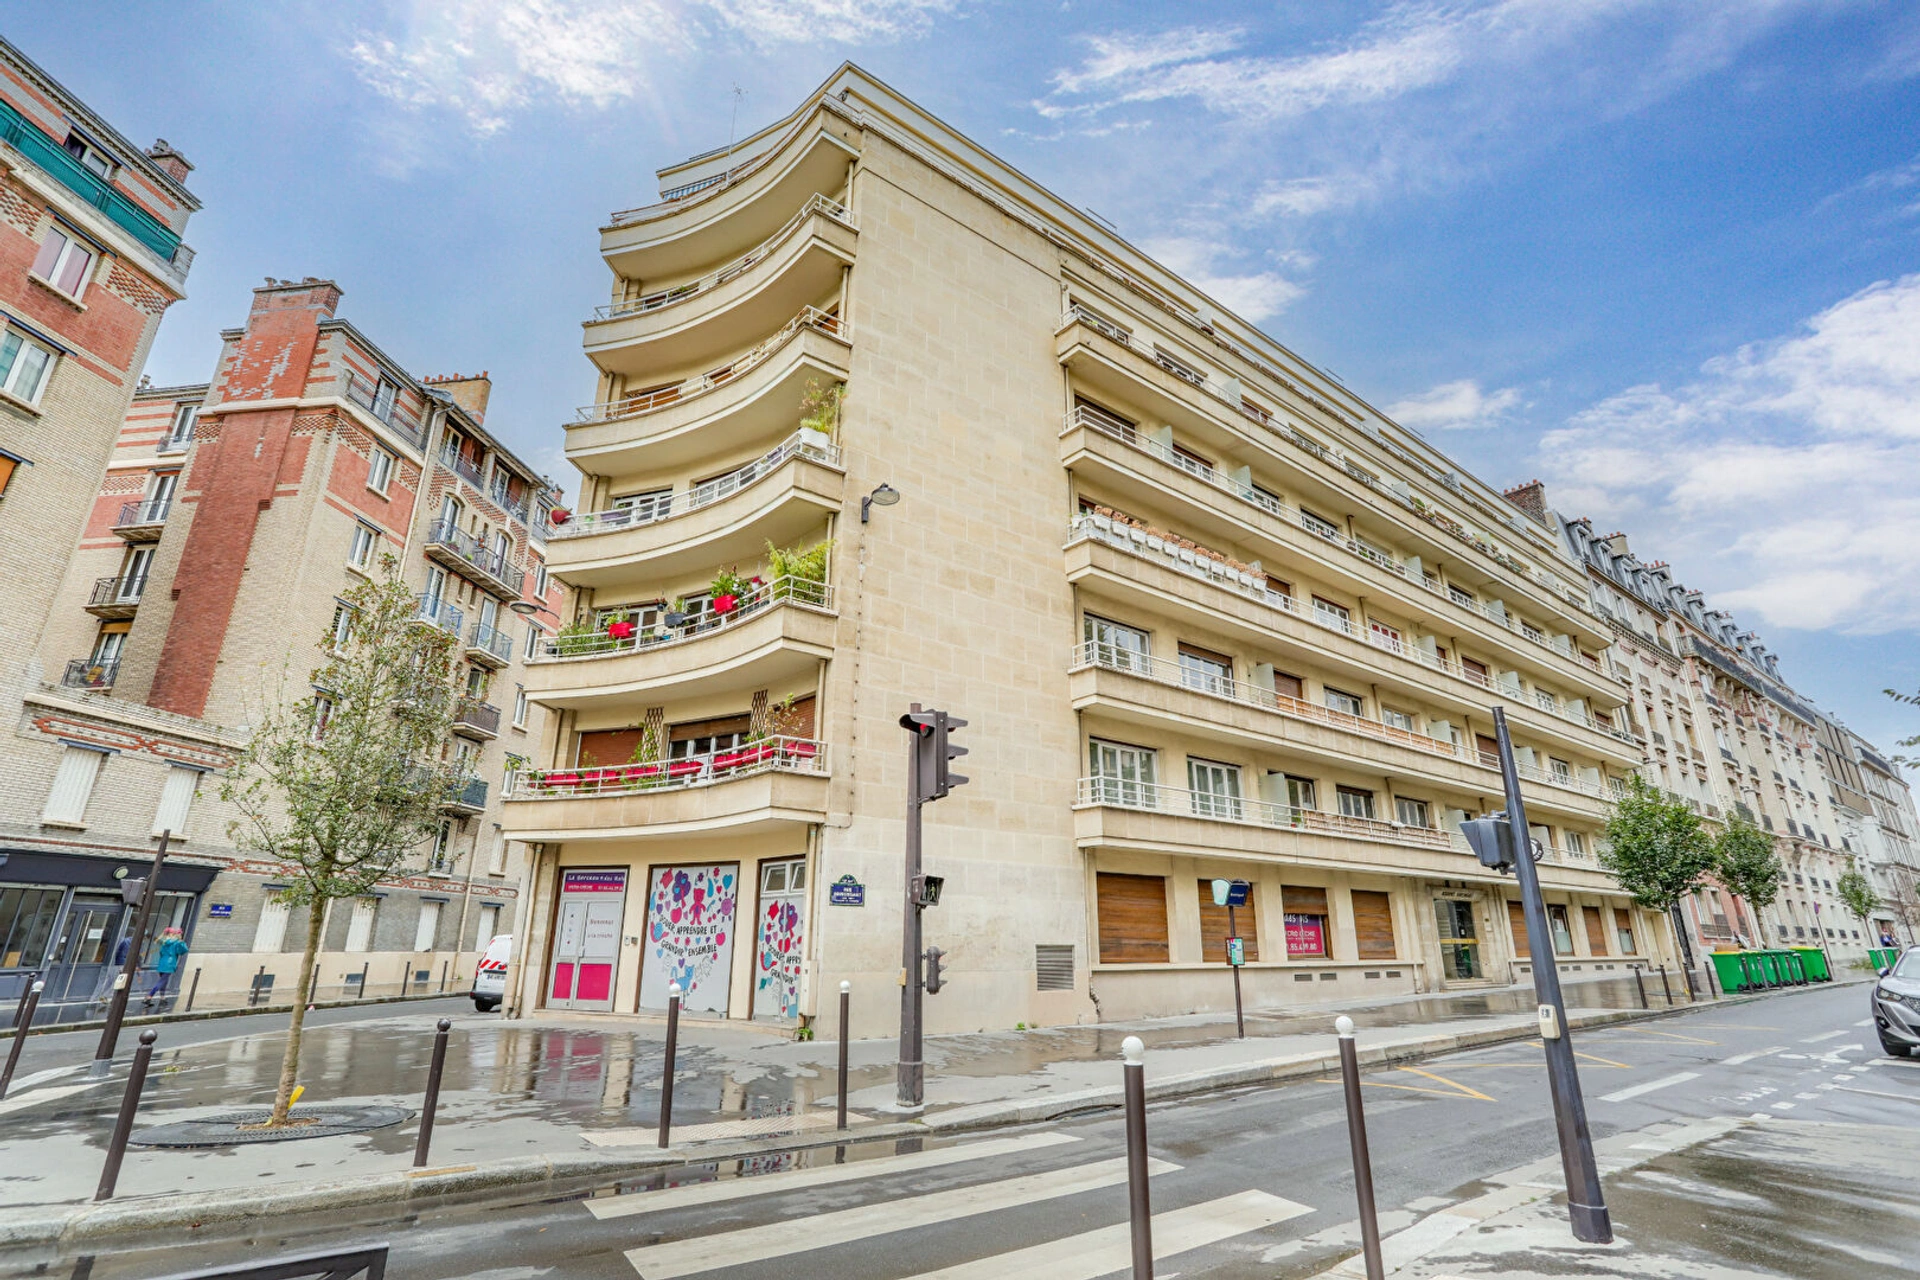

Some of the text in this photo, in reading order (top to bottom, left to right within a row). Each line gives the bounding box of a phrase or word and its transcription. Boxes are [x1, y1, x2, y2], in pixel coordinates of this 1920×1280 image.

[676, 926, 708, 935] APPRENDRE
[710, 924, 718, 934] ET
[688, 944, 717, 957] ENSEMBLE
